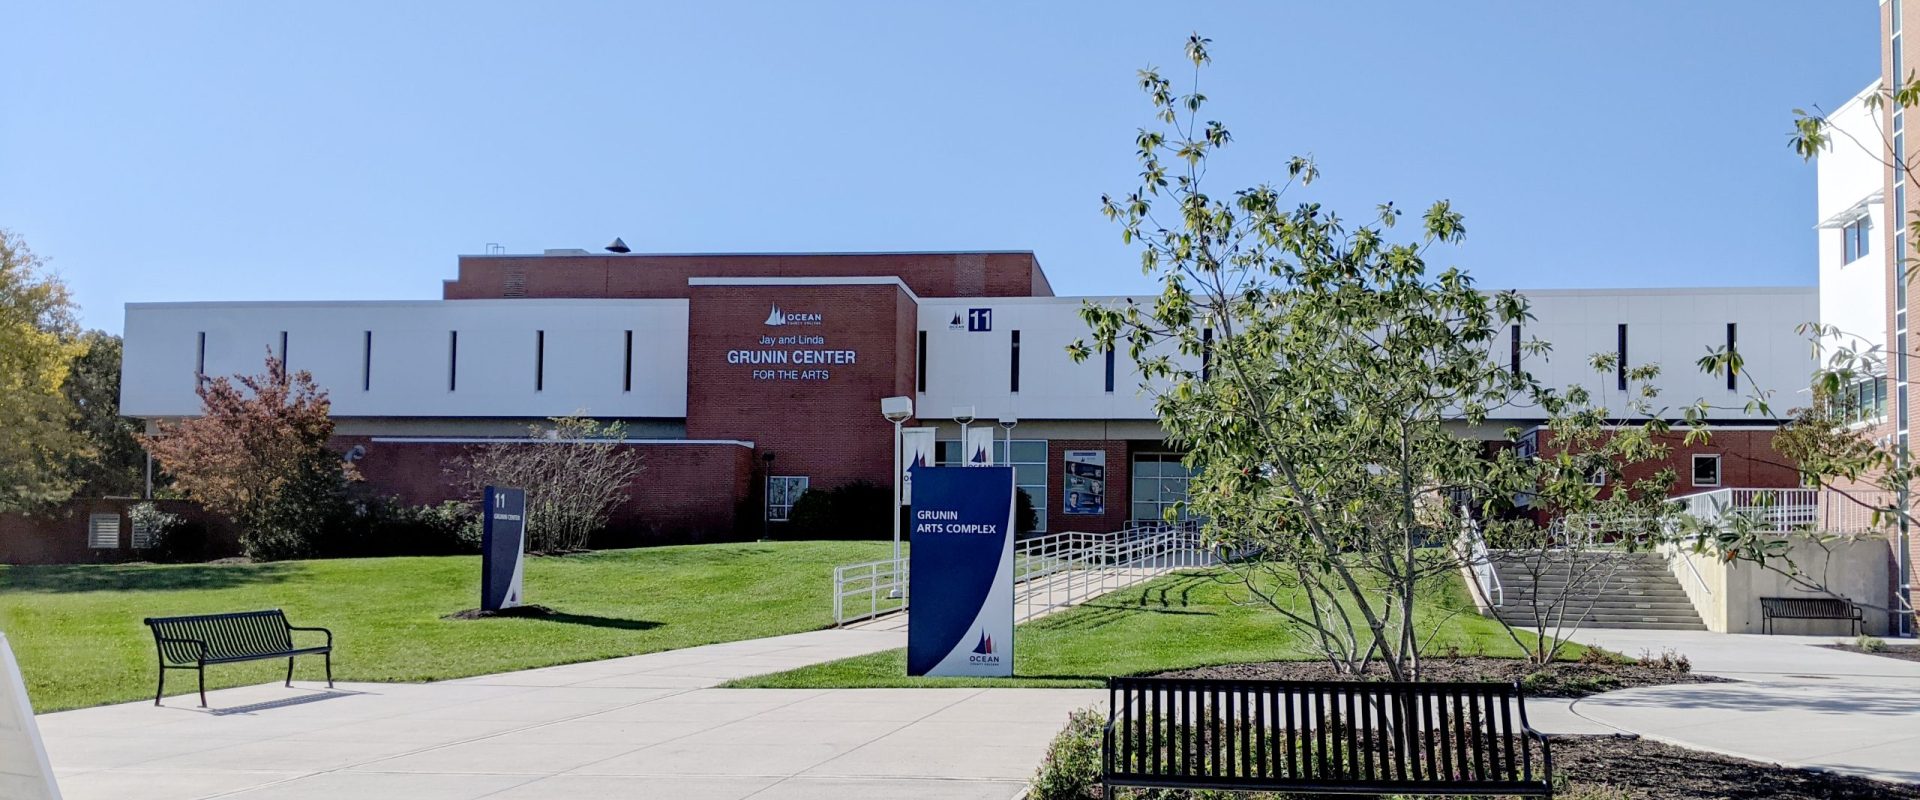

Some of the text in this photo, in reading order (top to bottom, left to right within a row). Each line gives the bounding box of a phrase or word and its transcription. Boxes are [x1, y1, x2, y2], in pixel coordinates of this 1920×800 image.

[787, 313, 822, 321] OCEAN
[970, 310, 991, 330] 11
[759, 335, 825, 346] Jay and Linda
[727, 349, 856, 364] GRUNIN CENTER
[753, 370, 829, 380] FOR THE ARTS
[495, 493, 505, 508] 11
[917, 510, 958, 520] GRUNIN
[916, 523, 997, 534] ARTS COMPLEX
[969, 655, 1000, 663] OCEAN
